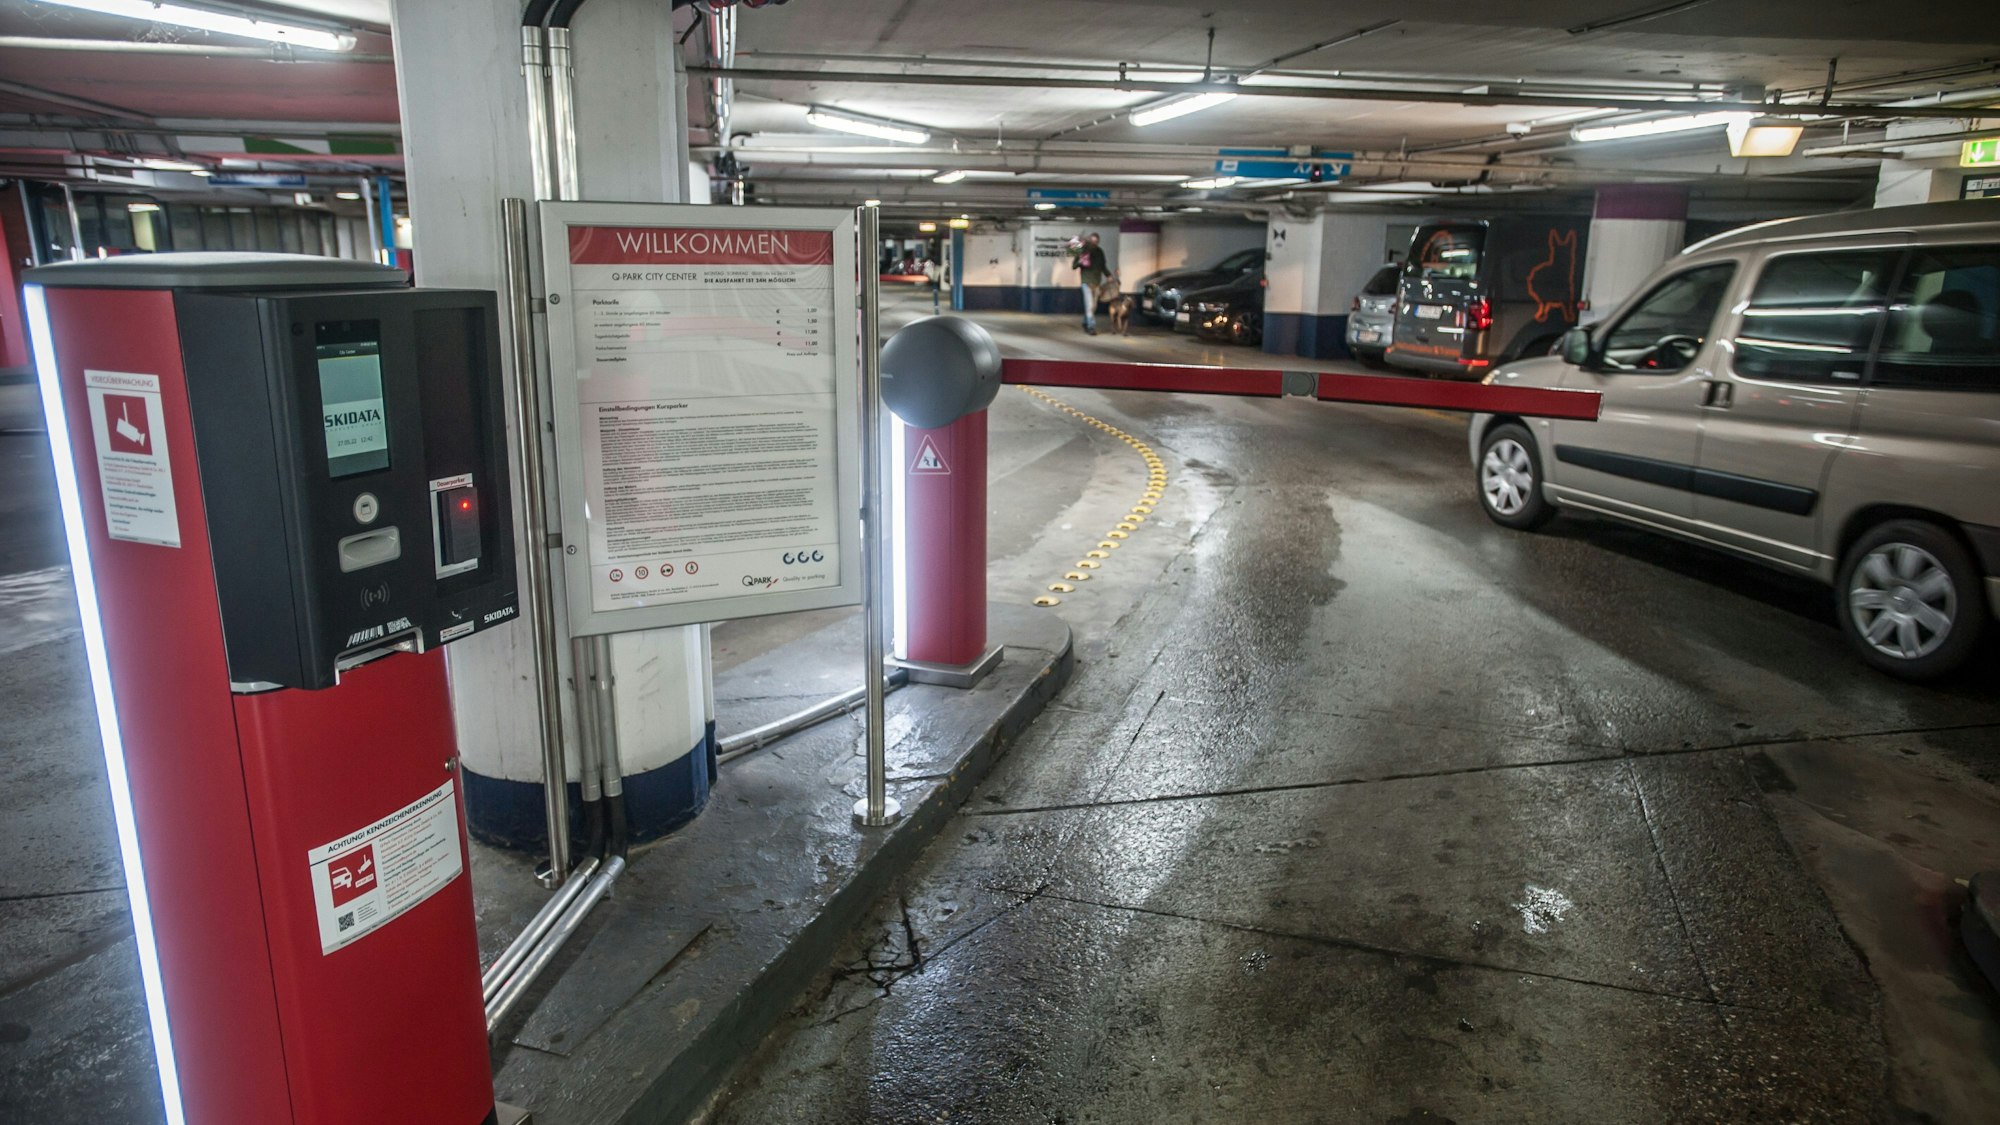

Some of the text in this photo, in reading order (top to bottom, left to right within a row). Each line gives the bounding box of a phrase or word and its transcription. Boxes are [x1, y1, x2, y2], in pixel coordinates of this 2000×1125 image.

[616, 231, 789, 255] WILLKOMMEN
[645, 272, 664, 281] CITY
[665, 272, 698, 281] CENTER
[91, 375, 154, 387] VIDEOÜBERWACHUNG
[598, 404, 656, 413] Einstellbedingungen
[324, 408, 381, 428] SKIDATA
[436, 476, 465, 488] Dauerparker
[484, 606, 514, 624] SKIDATA
[327, 833, 365, 854] ACHTUNG!
[366, 789, 443, 836] KENNZEICHENERKENNUNG
